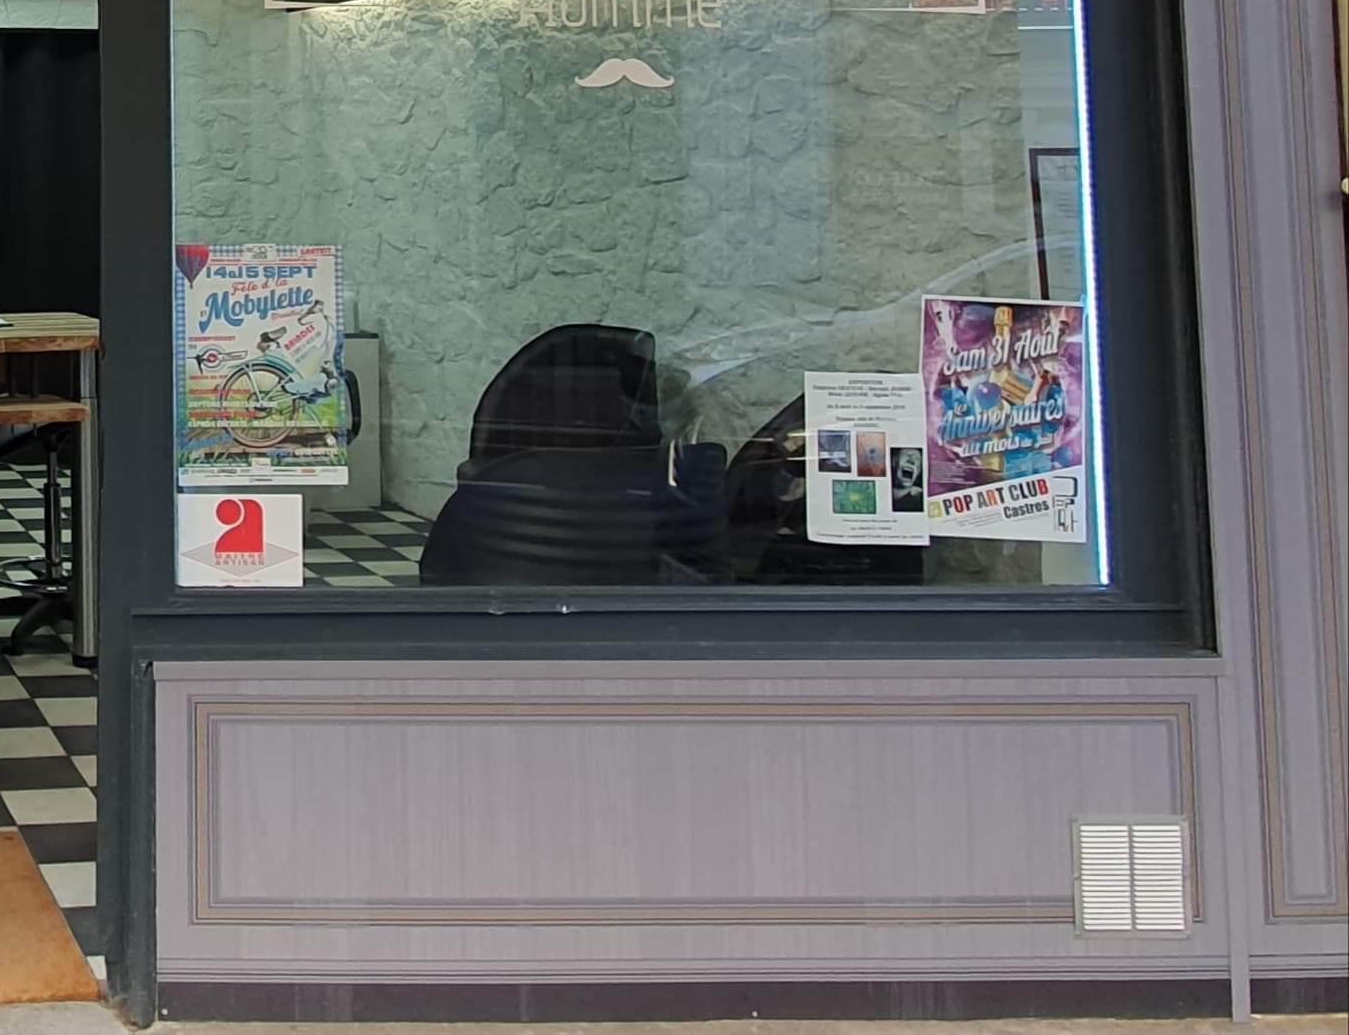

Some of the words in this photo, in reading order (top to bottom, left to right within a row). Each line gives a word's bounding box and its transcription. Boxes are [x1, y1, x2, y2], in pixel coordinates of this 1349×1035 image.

[263, 266, 317, 278] SEPT
[199, 288, 314, 333] Mobylette
[944, 346, 986, 376] Sam
[988, 335, 1010, 363] 31
[939, 397, 1064, 445] Anniversaires
[944, 495, 973, 516] POP
[977, 487, 1006, 509] ART
[1008, 479, 1049, 504] CLUB
[1004, 499, 1050, 520] Castres
